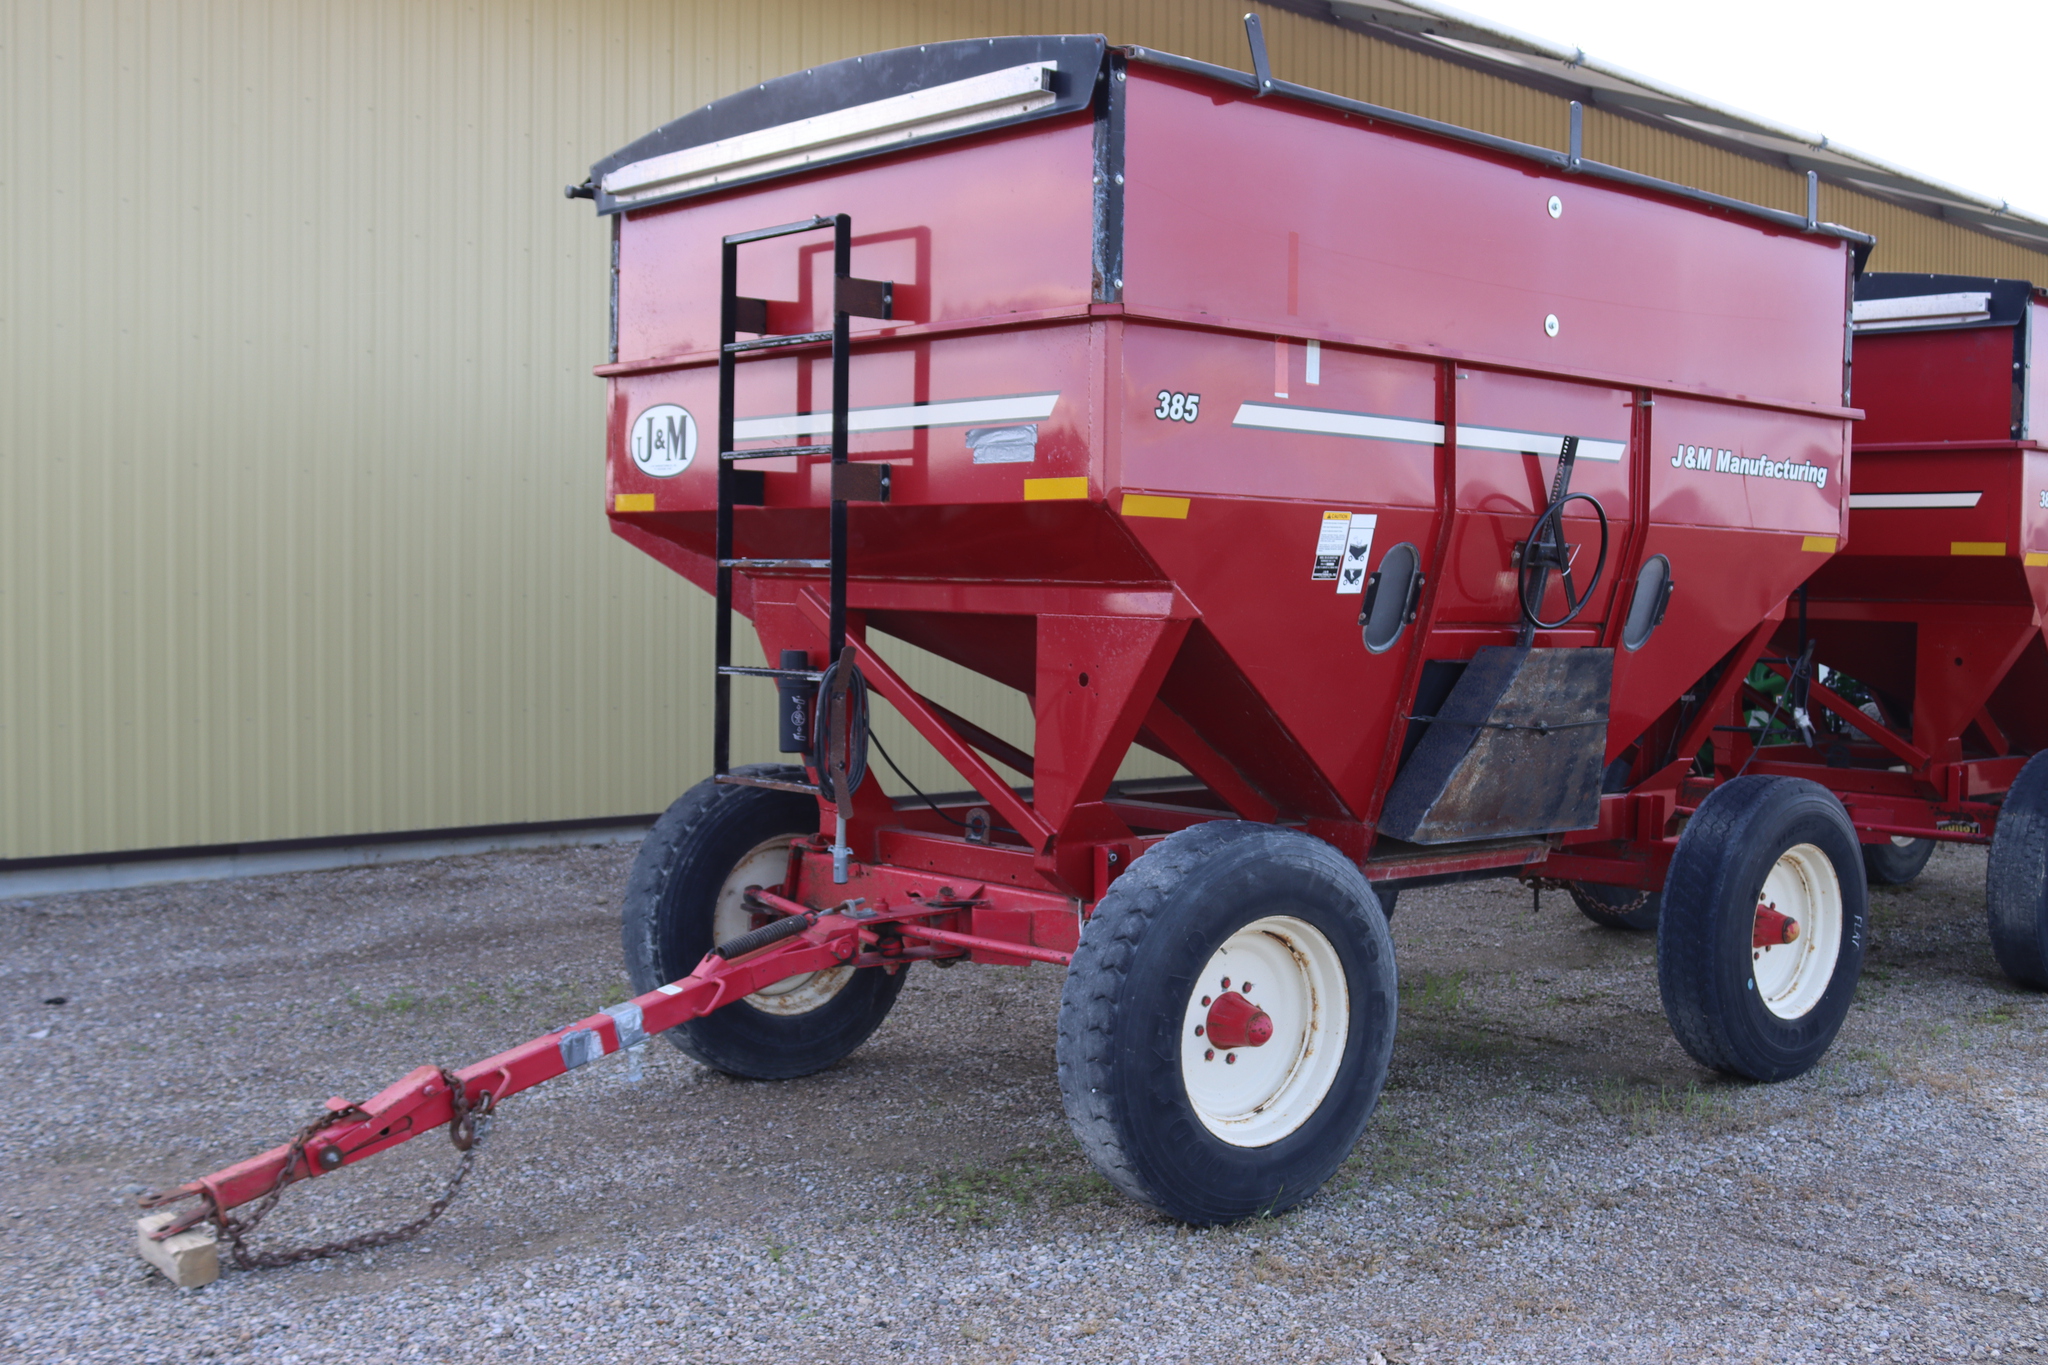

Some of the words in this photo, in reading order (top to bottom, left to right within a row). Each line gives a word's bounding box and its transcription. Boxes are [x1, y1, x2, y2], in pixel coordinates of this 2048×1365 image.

[1154, 389, 1201, 424] 385
[636, 414, 688, 463] J&M
[1671, 444, 1713, 471] J&M
[1714, 449, 1828, 489] Manufacturing
[1852, 913, 1863, 952] FLAT
